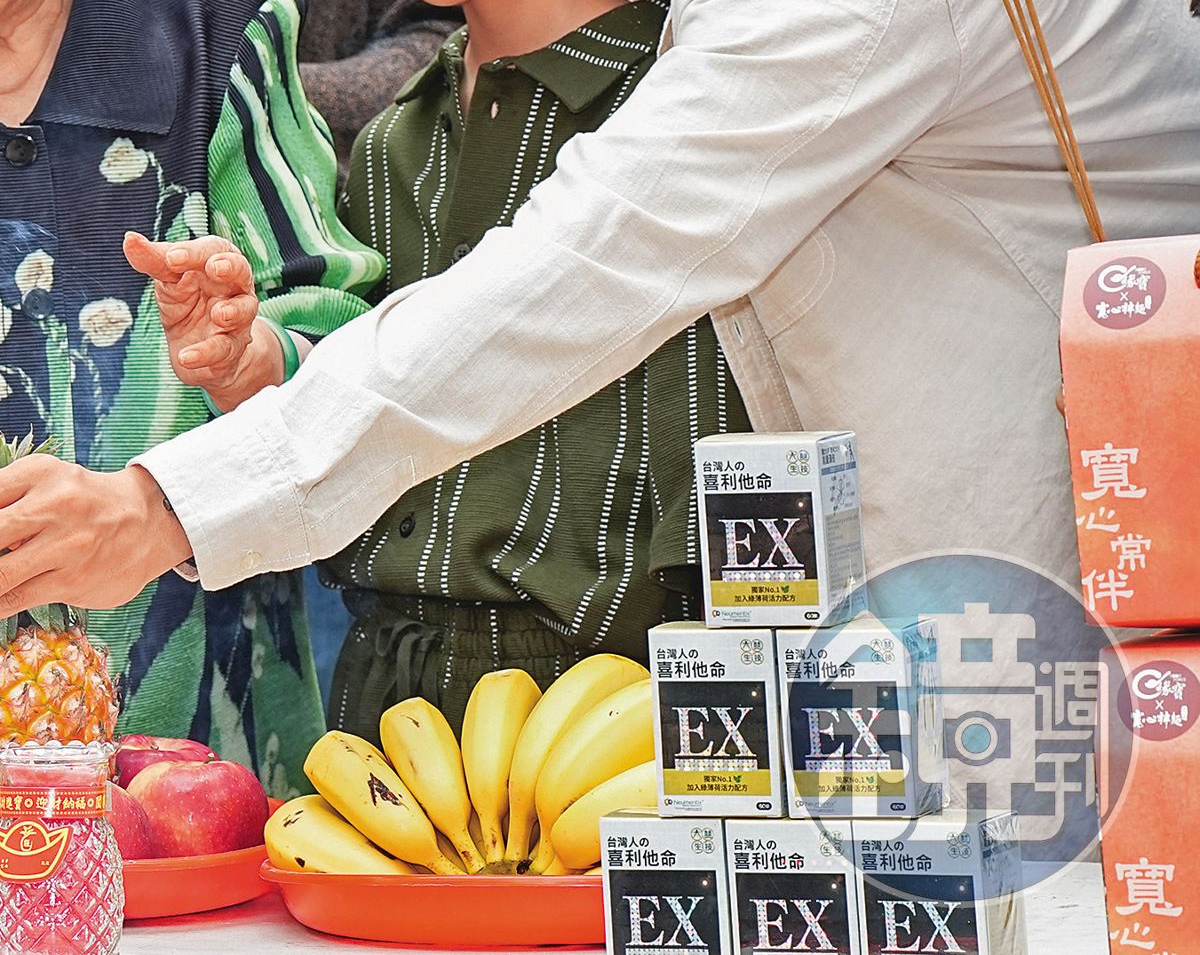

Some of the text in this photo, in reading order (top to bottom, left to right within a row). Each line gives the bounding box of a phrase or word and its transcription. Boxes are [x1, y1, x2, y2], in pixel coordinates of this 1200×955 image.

[703, 461, 745, 472] 台灣人の
[703, 473, 772, 491] 喜利他命
[718, 518, 805, 569] EX
[656, 649, 699, 660] 台灣人の
[657, 661, 726, 679] 喜利他命
[672, 707, 757, 757] EX
[801, 707, 890, 758] EX
[607, 837, 649, 847] 台灣人の
[607, 849, 676, 867] 喜利他命
[734, 852, 804, 870] 喜利他命
[862, 853, 932, 871] 喜利他命
[1110, 857, 1183, 955] 寬心
[622, 895, 709, 946] EX
[750, 899, 838, 950] EX
[877, 900, 966, 953] EX
